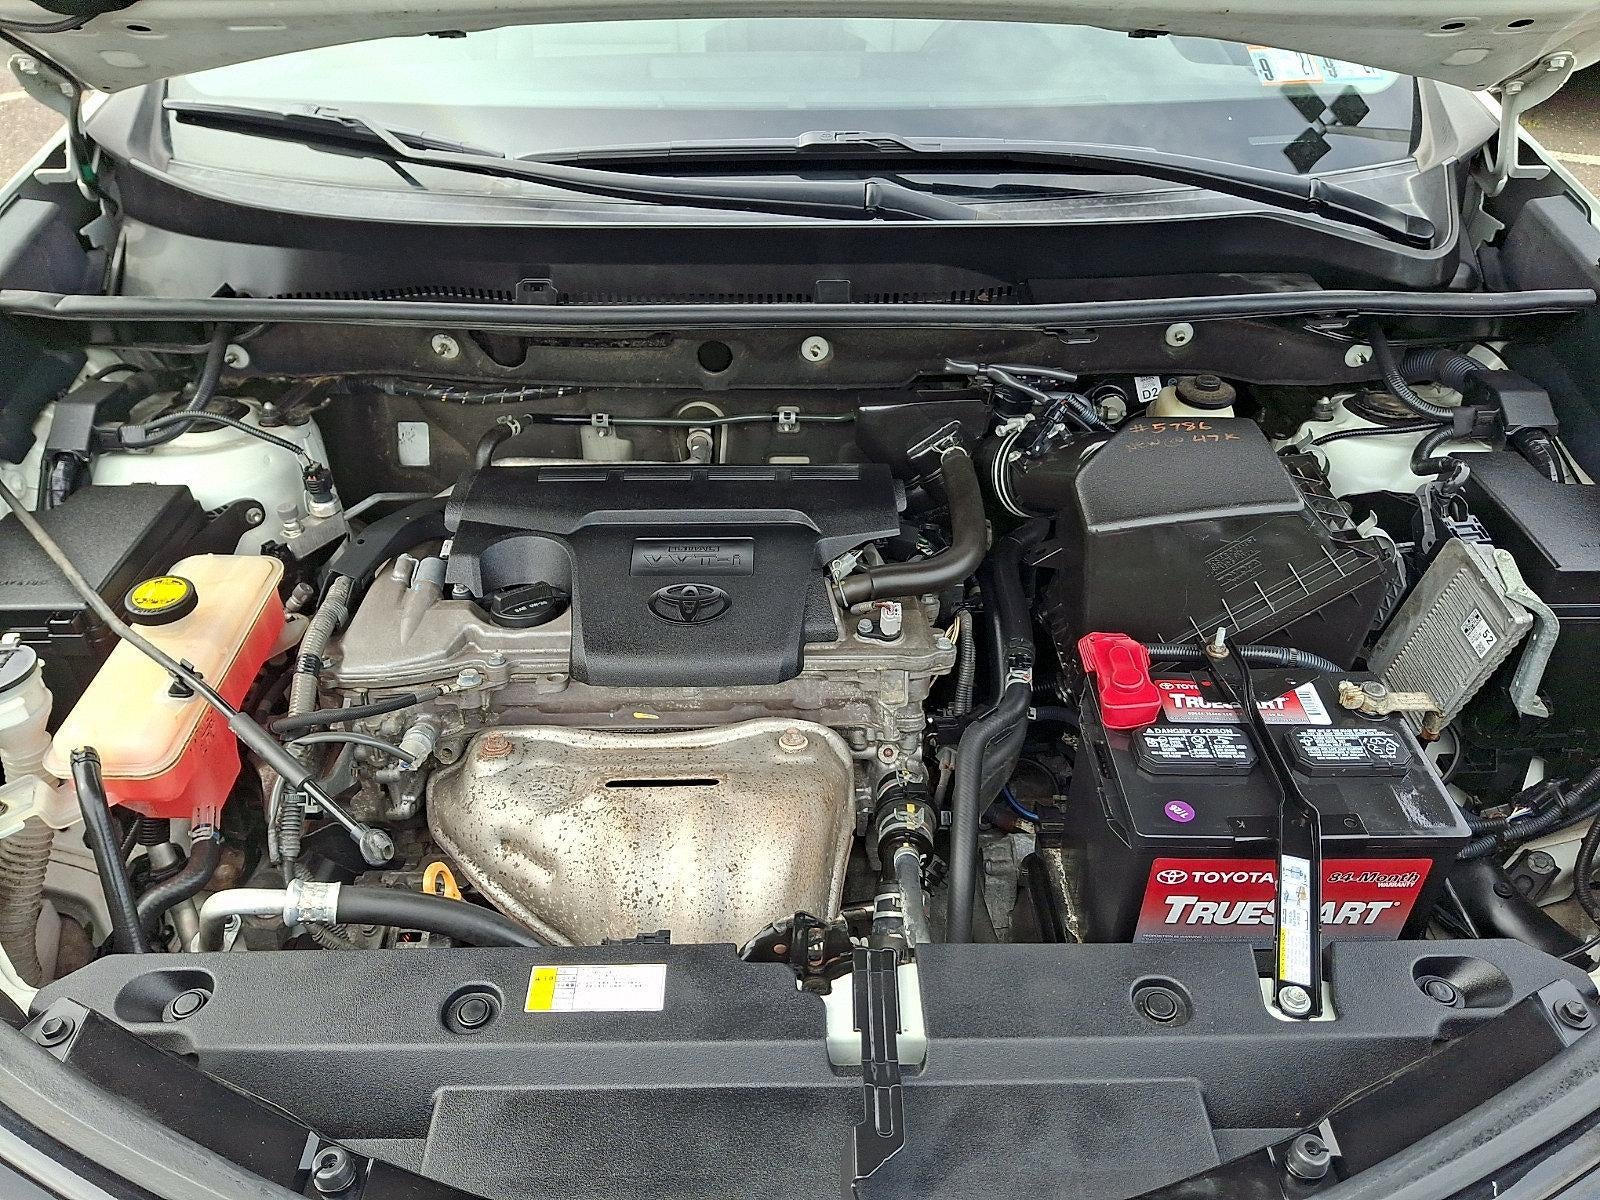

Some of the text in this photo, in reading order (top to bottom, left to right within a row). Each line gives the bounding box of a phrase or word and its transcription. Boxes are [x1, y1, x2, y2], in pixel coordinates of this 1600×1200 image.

[1142, 387, 1159, 399] D2
[1482, 629, 1494, 645] 52
[1190, 871, 1275, 884] TOYOTA
